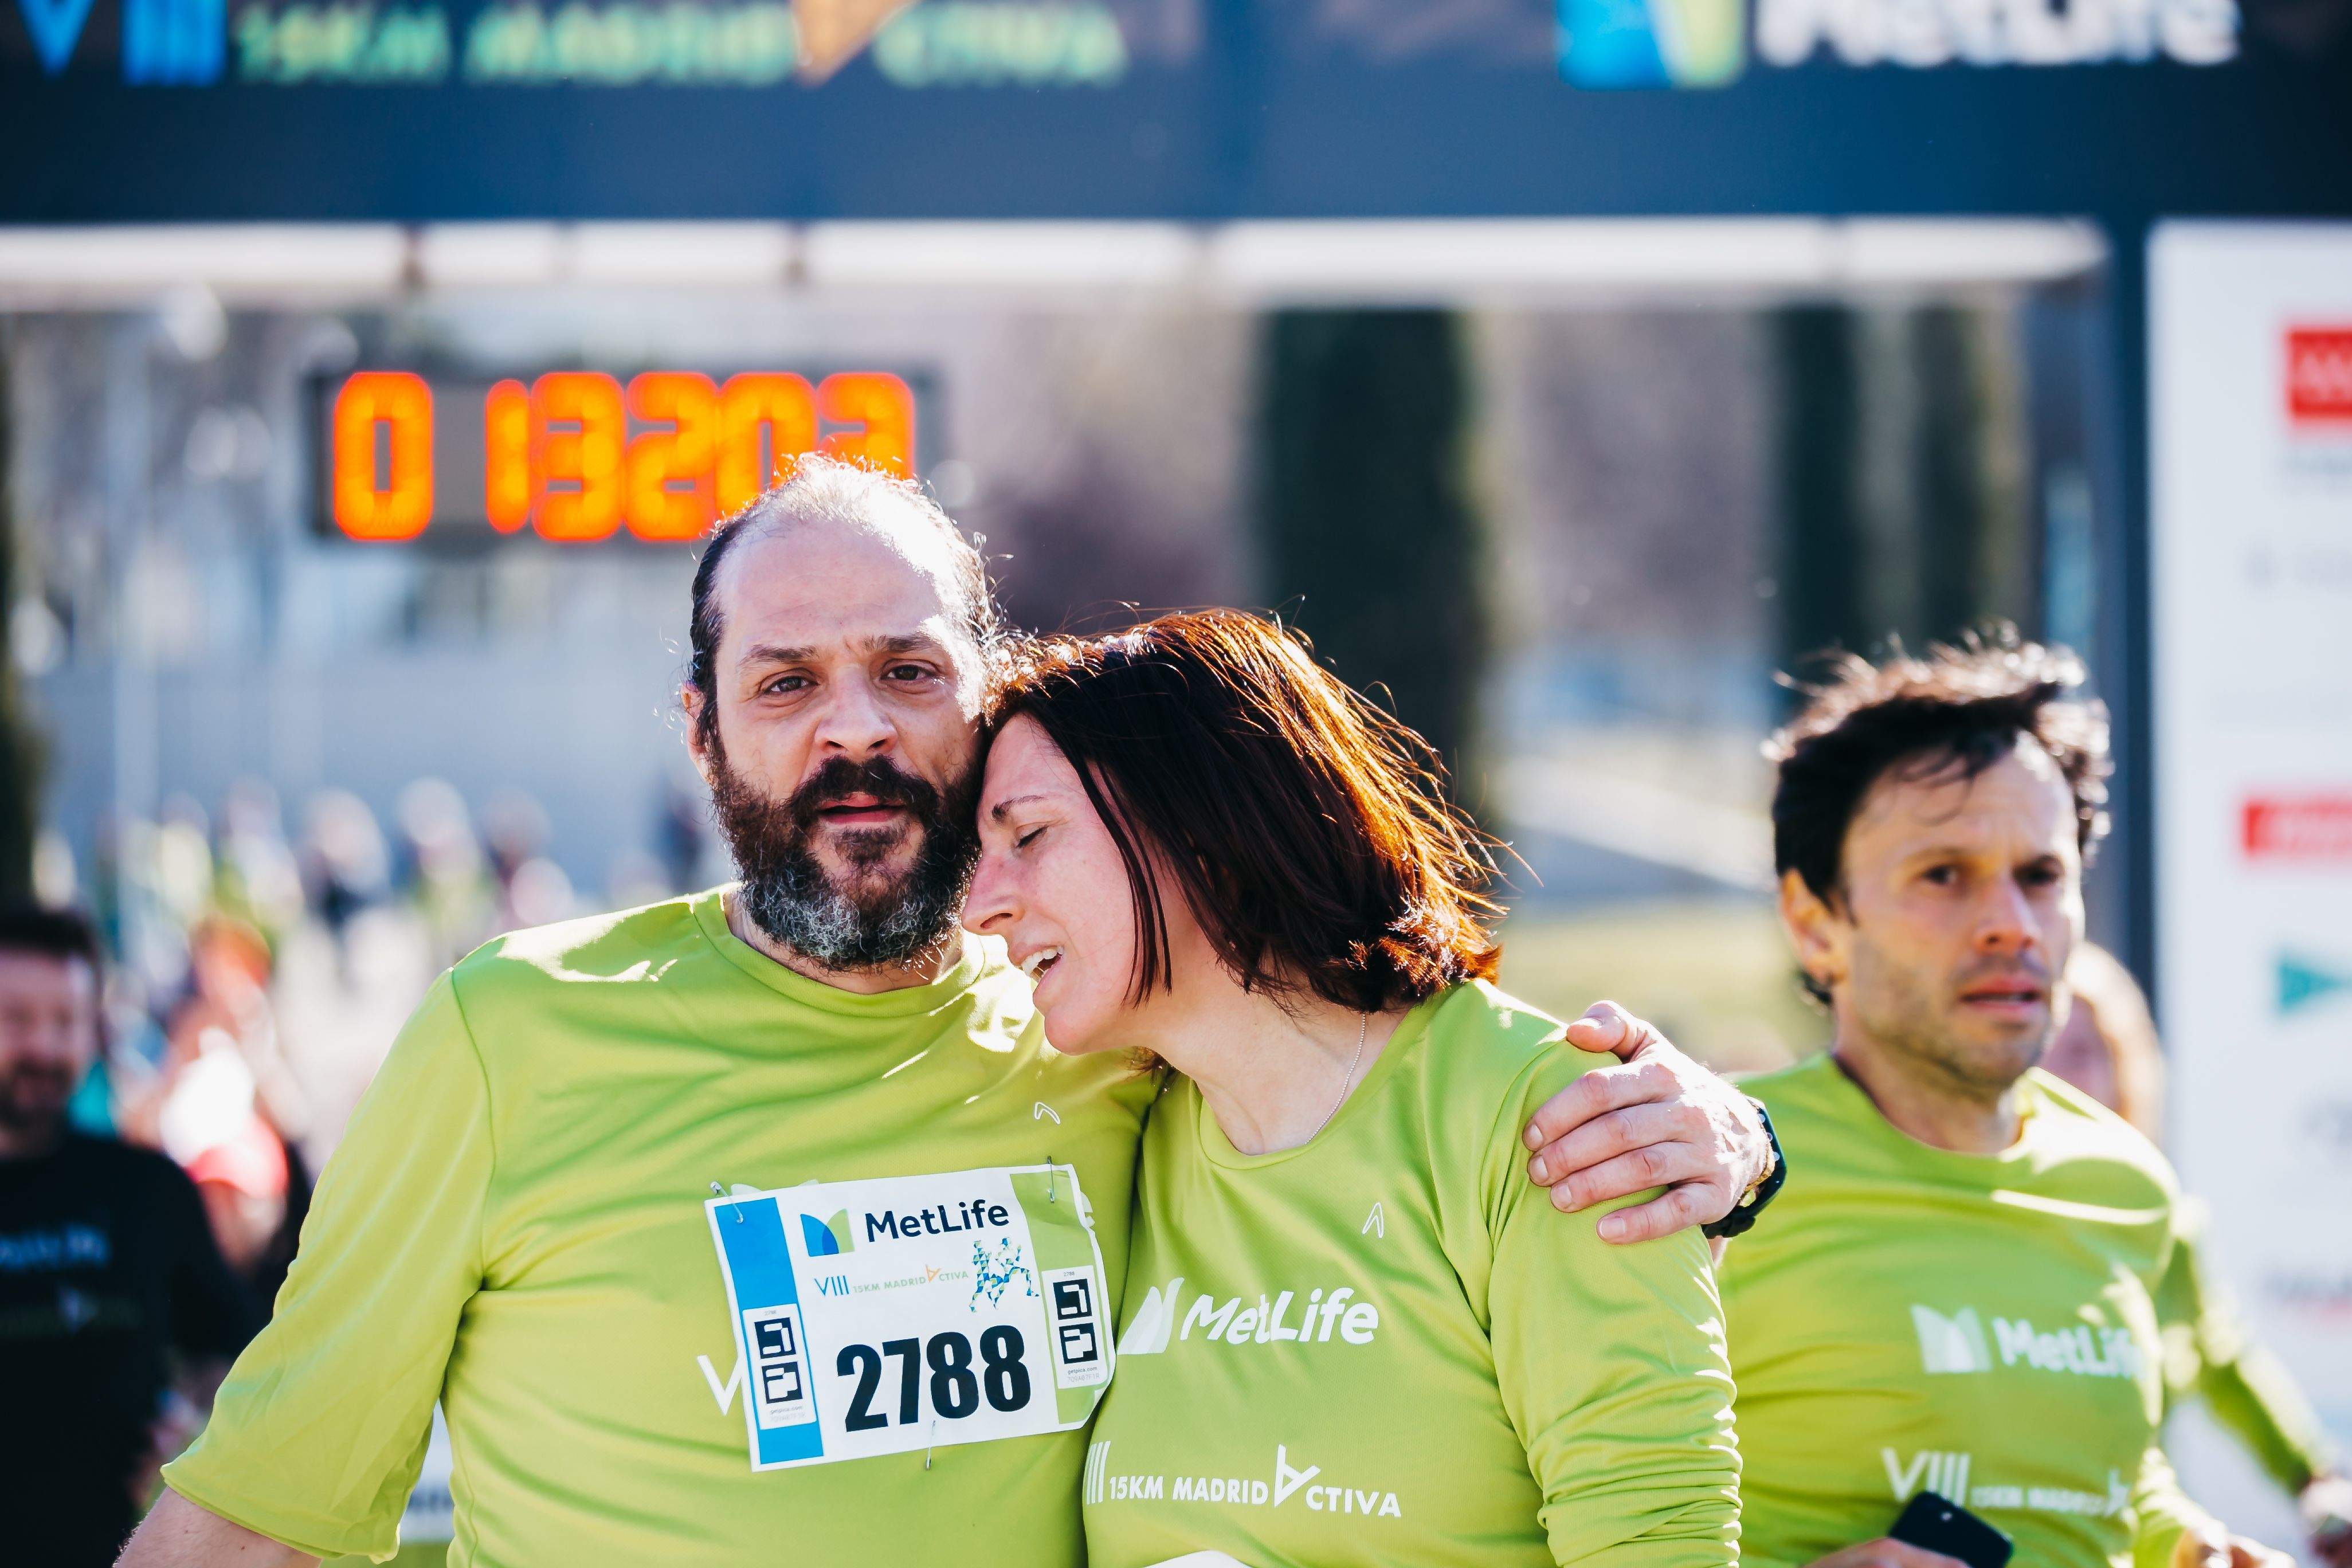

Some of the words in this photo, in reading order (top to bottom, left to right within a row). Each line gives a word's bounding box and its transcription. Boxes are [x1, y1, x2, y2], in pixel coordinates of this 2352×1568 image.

[865, 1199, 1010, 1243] MetLife
[814, 1275, 849, 1297] VIII
[853, 1283, 881, 1294] 15KM
[884, 1276, 927, 1291] MADRID
[1180, 1287, 1379, 1344] MetLife
[837, 1325, 1032, 1433] 2788
[1110, 1475, 1164, 1500] 15KM
[1172, 1476, 1269, 1505] MADRID
